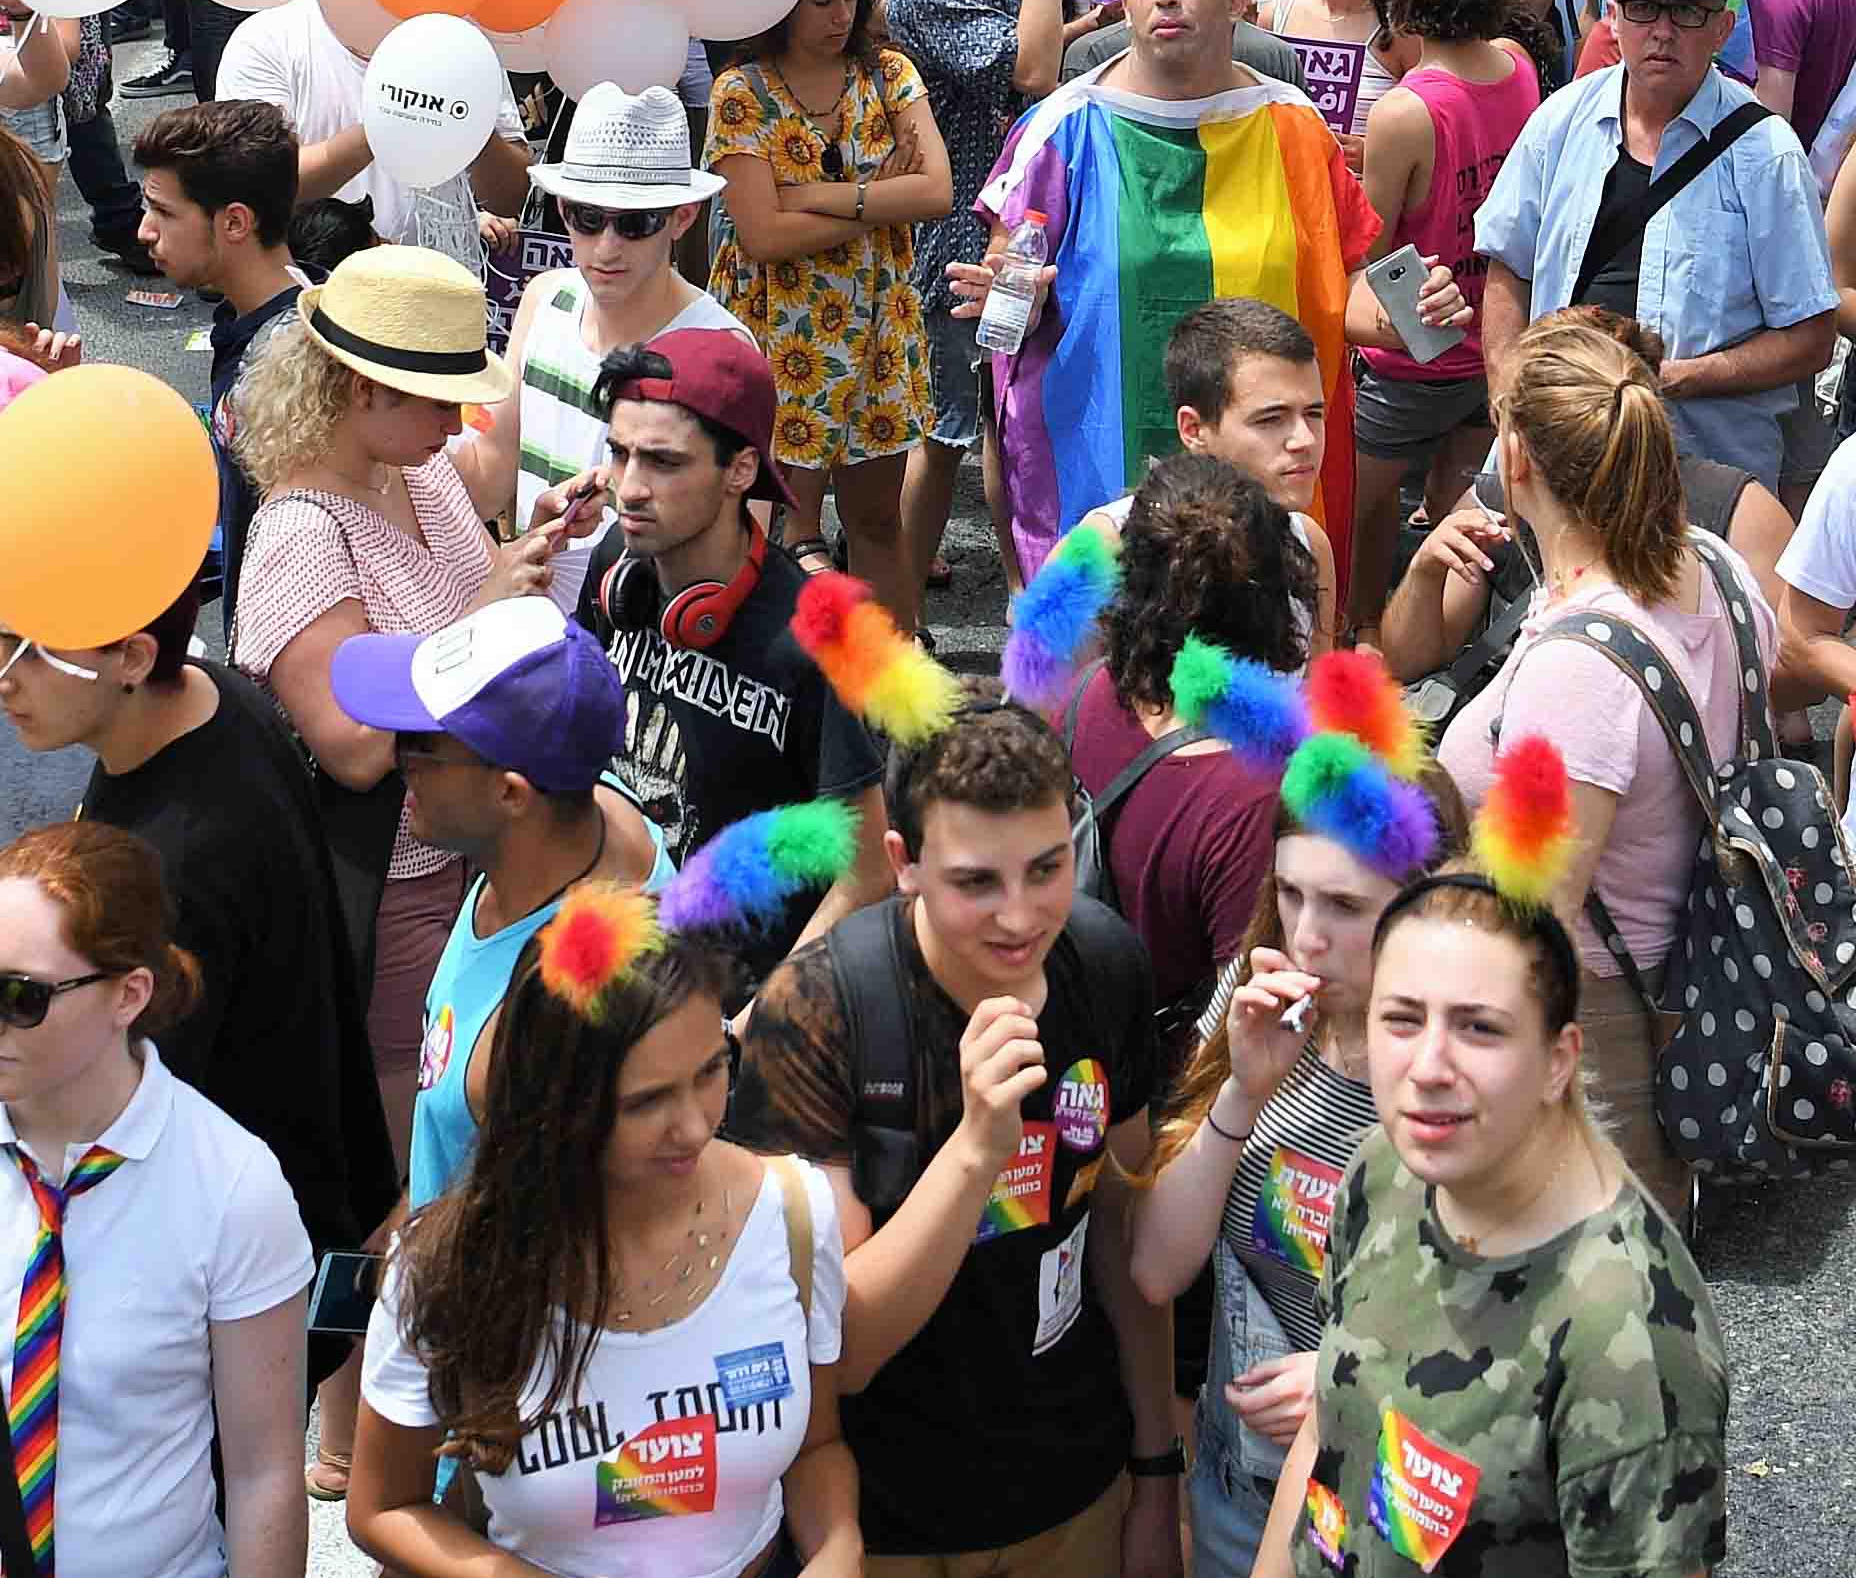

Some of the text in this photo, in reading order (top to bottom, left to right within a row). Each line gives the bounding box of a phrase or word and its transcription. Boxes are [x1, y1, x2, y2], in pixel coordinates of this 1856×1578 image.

[381, 82, 446, 112] אנקורי
[525, 240, 573, 269] אה
[637, 628, 790, 753] MAIDEN
[1060, 1079, 1105, 1109] גאה
[1018, 1133, 1045, 1158] צו
[1279, 1166, 1339, 1207] ועדת
[517, 1400, 625, 1476] COOL
